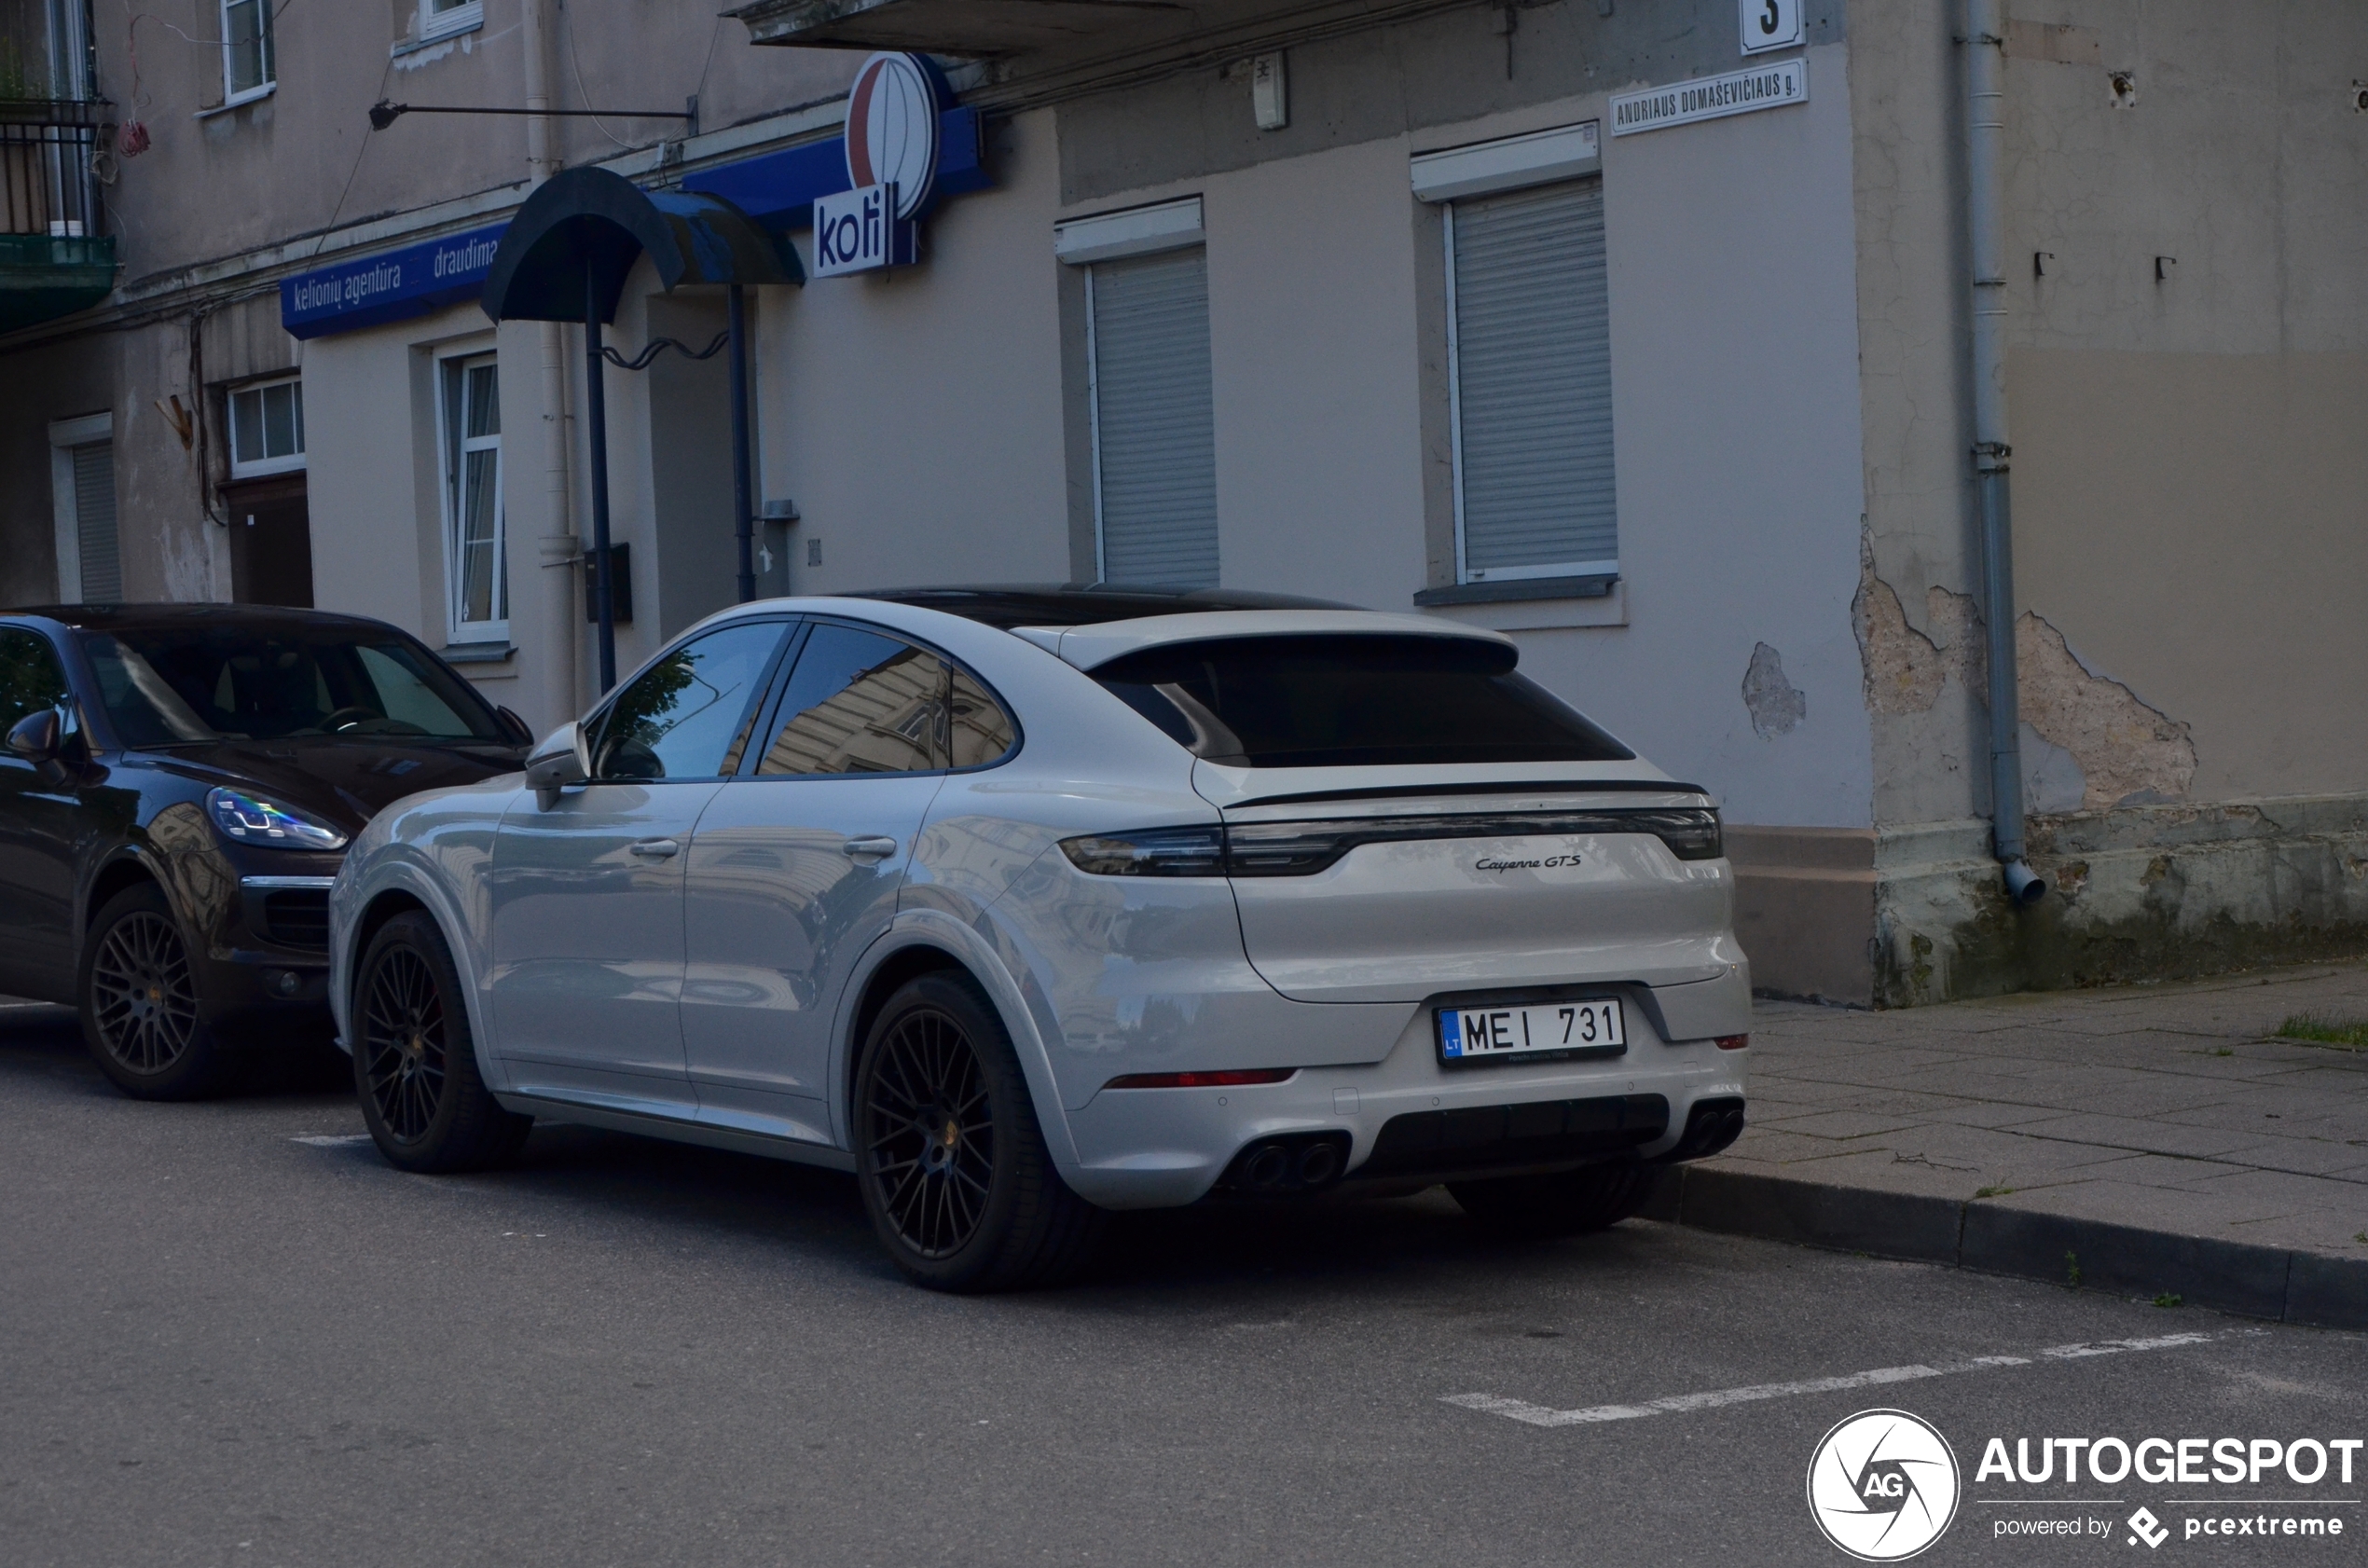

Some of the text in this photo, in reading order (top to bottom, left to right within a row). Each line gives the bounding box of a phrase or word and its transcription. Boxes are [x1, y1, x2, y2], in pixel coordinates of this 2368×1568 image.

[1760, 0, 1779, 34] 3
[1618, 74, 1796, 125] ANDRIAUS DOMAŠEVIČIAUS g.
[819, 189, 880, 268] koti
[434, 238, 502, 279] draudima
[294, 262, 401, 309] kelionių agentūra
[1475, 855, 1581, 874] Cayenne GTS
[1445, 1038, 1459, 1050] LT
[1465, 1005, 1614, 1051] MEI 731
